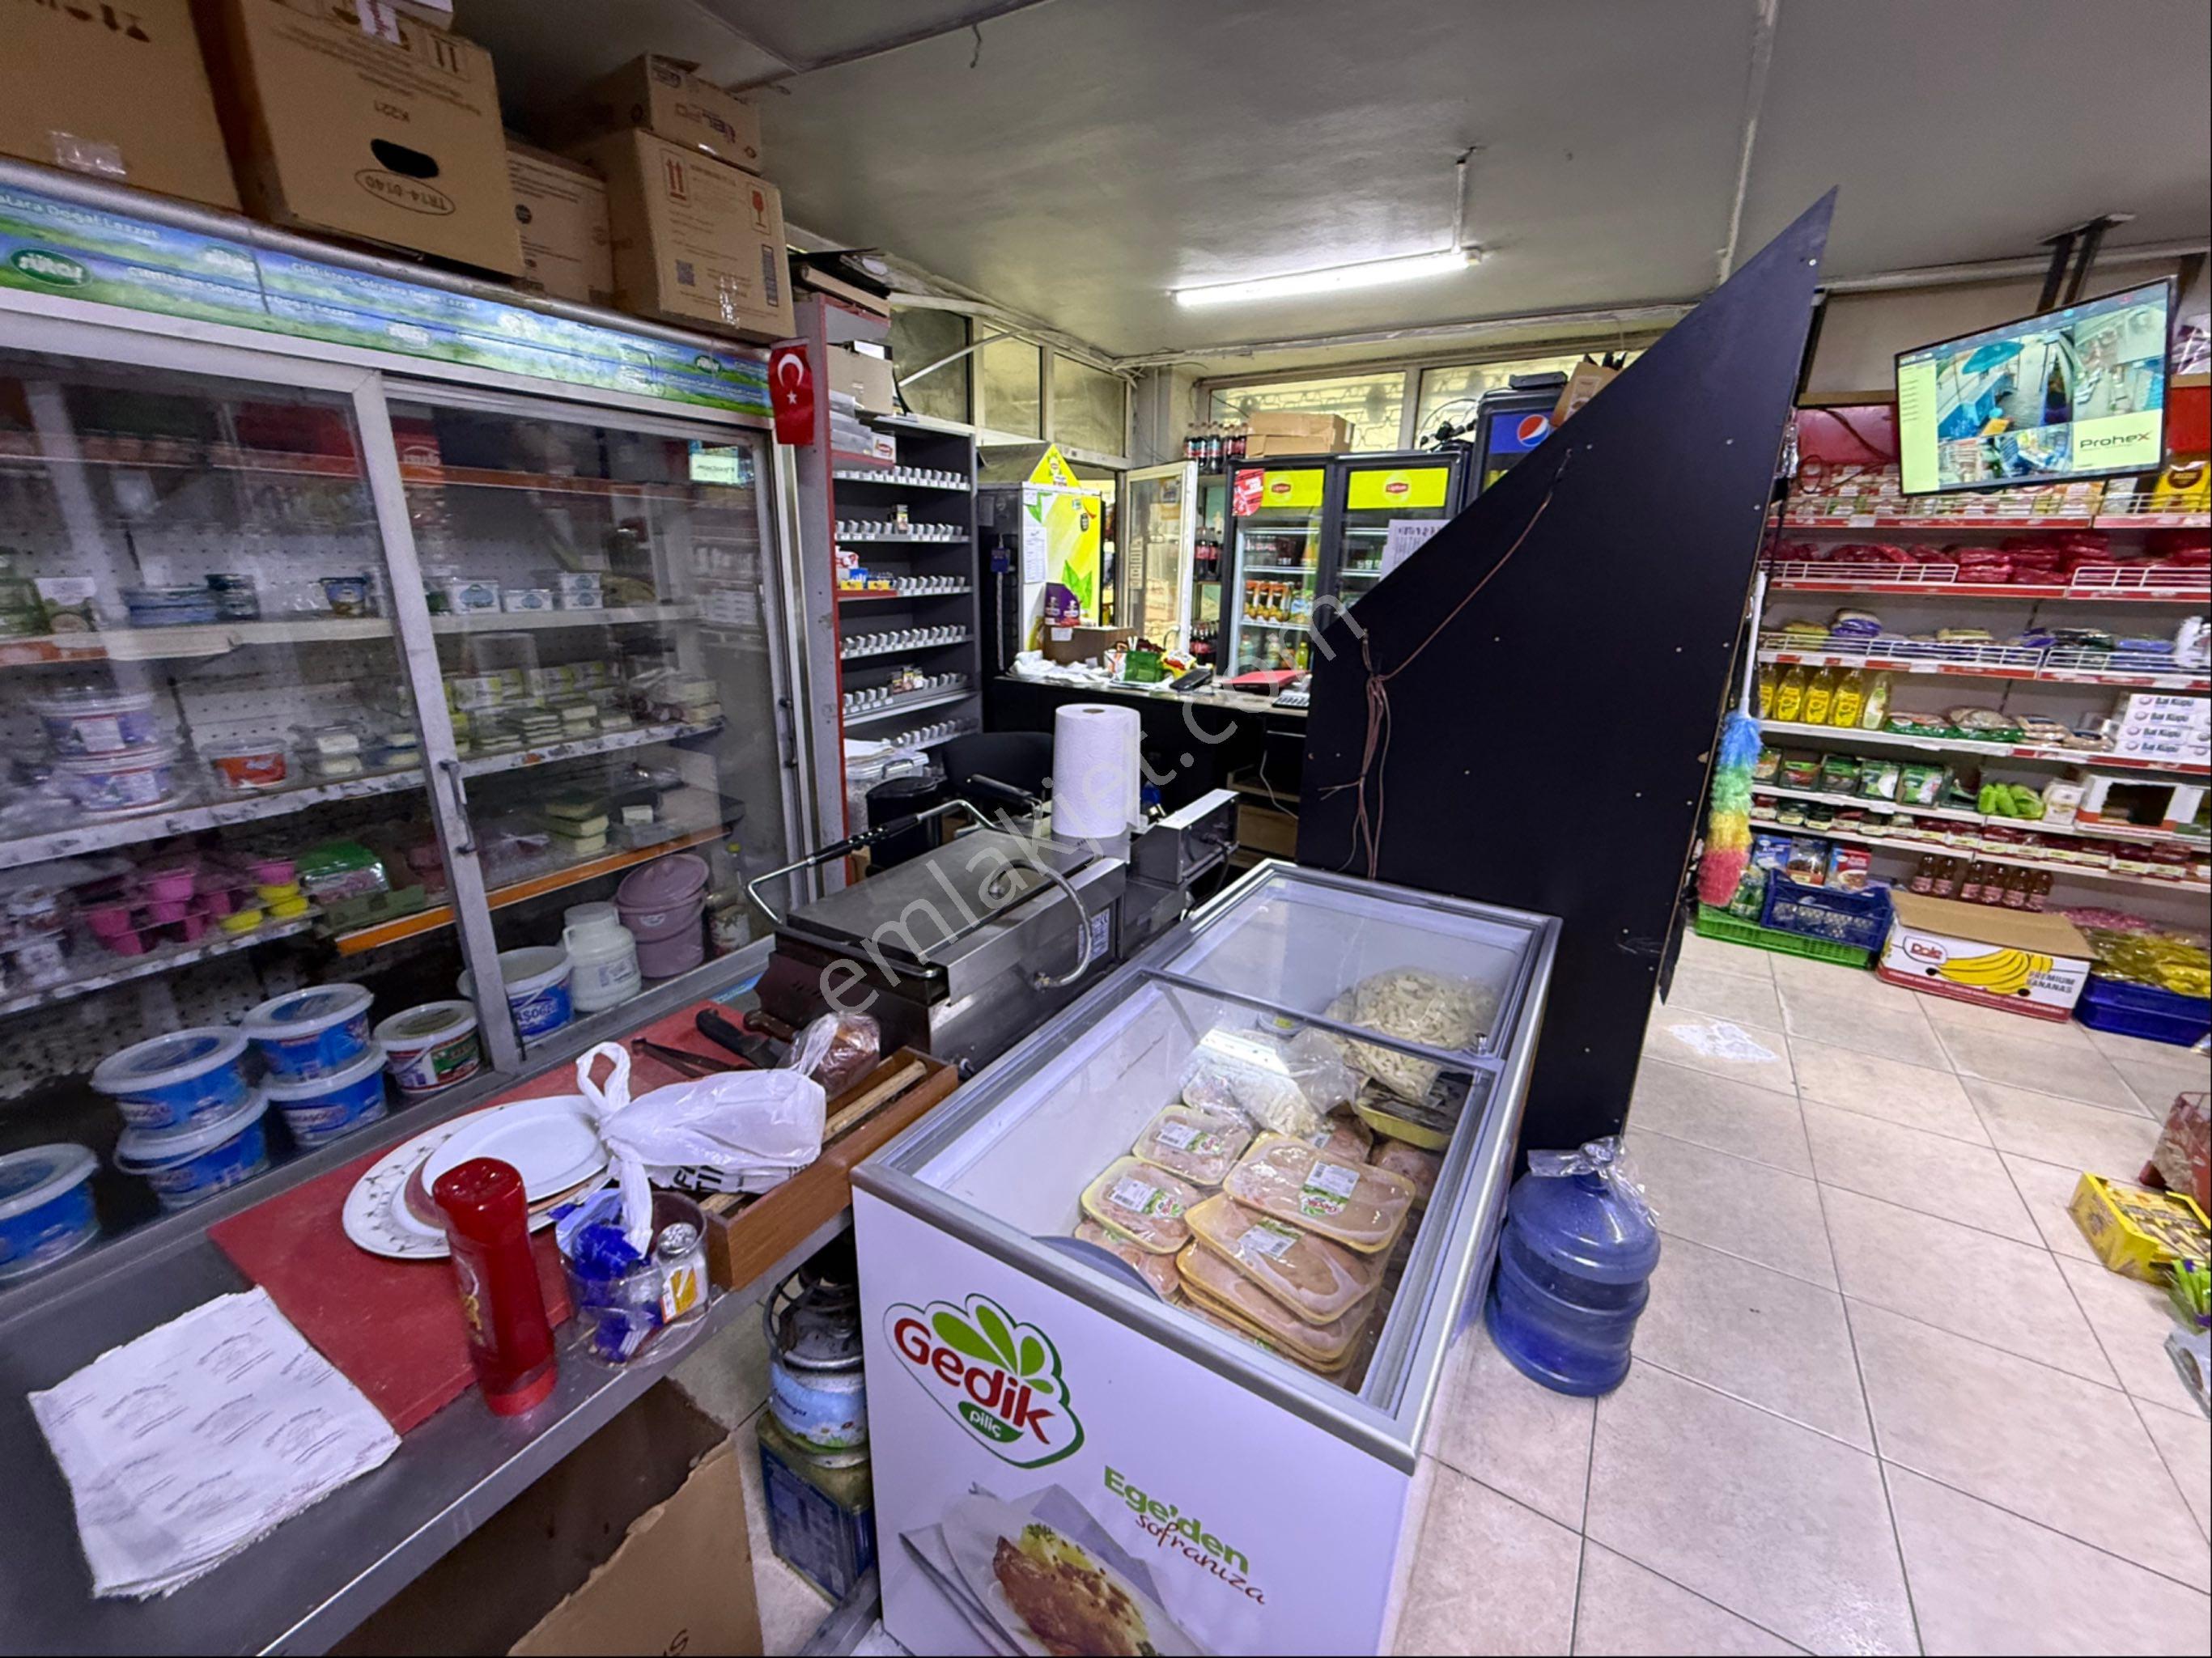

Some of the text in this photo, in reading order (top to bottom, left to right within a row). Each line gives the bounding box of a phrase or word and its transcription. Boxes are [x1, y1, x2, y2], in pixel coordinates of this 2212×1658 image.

[1910, 943, 1943, 960] Dole
[894, 1317, 1056, 1445] Gedik
[970, 1410, 1001, 1439] piliç
[1104, 1465, 1249, 1575] Ege'den
